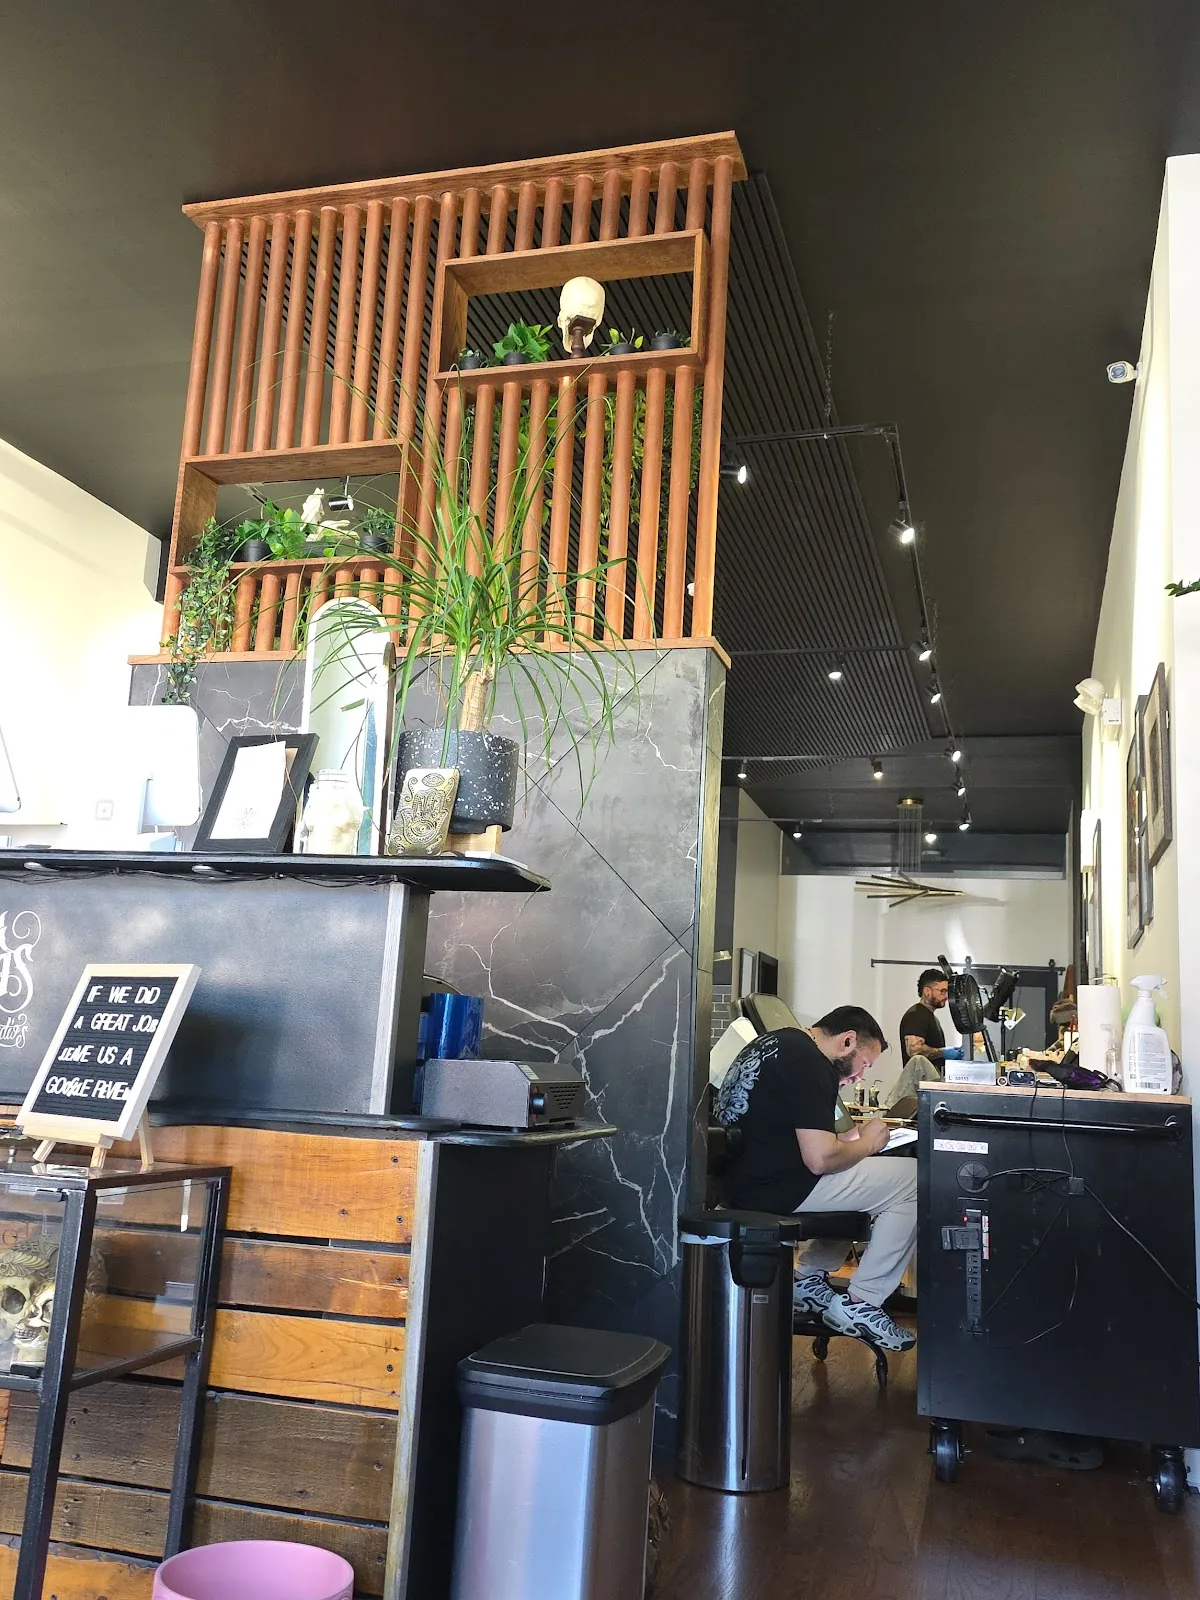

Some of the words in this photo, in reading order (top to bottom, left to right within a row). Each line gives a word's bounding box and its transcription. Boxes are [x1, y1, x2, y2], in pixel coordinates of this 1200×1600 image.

[87, 985, 104, 1003] IF
[108, 986, 132, 1004] WE
[134, 986, 161, 1005] DID
[73, 1015, 85, 1029] A
[90, 1012, 134, 1031] GREAT
[132, 1014, 160, 1033] JOB
[57, 1044, 95, 1063] LEAVE
[96, 1046, 118, 1065] US
[119, 1047, 134, 1066] A
